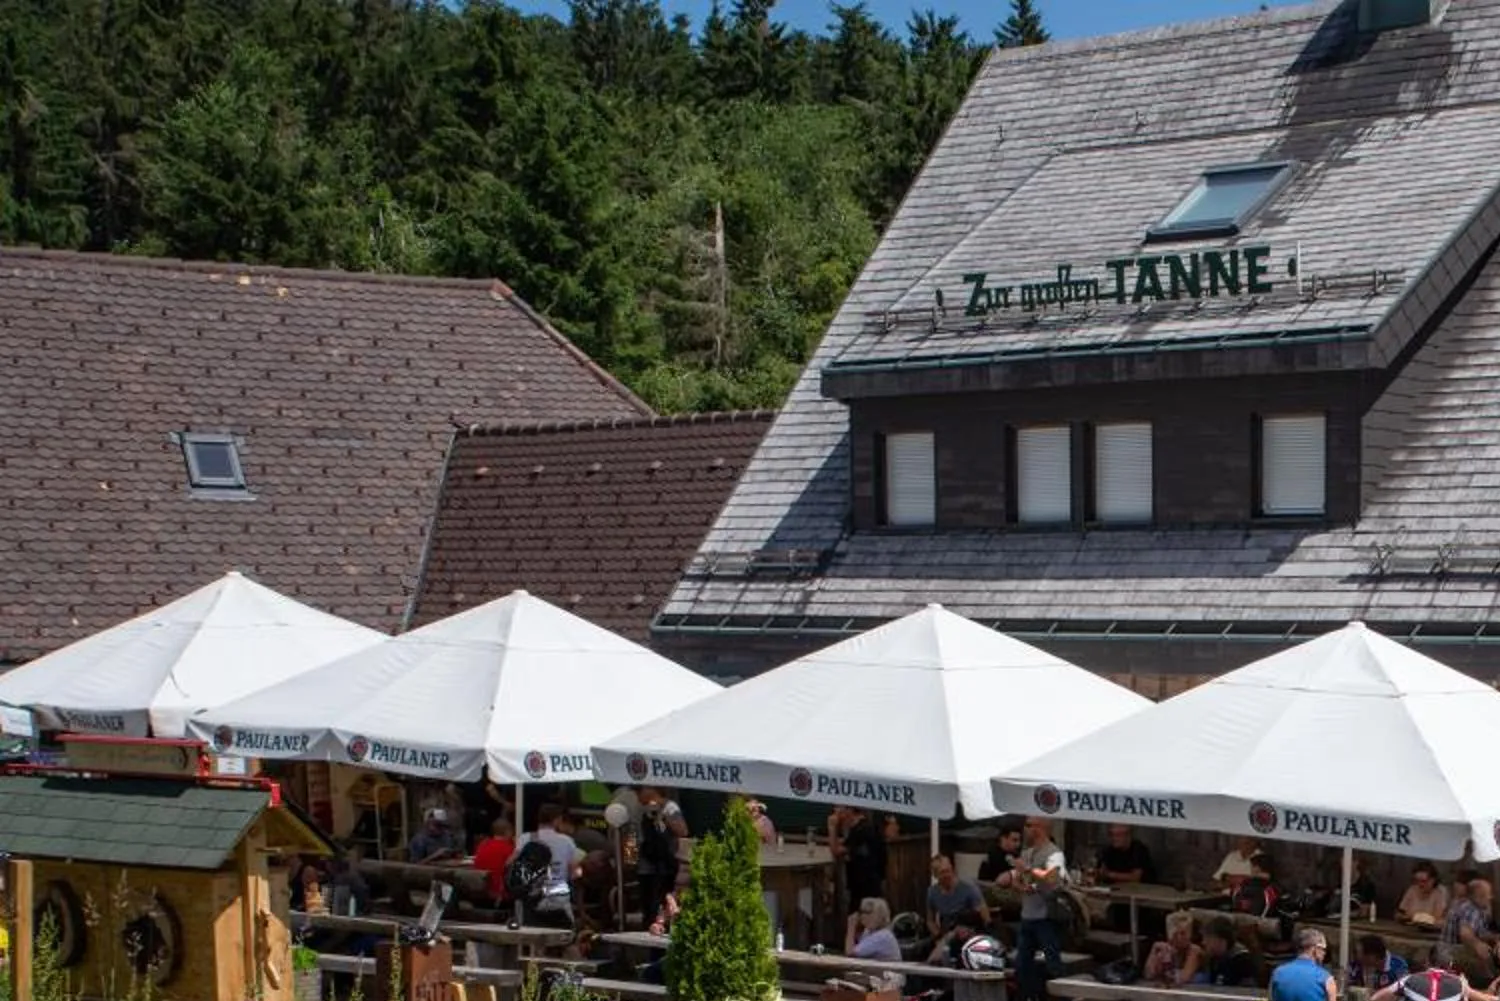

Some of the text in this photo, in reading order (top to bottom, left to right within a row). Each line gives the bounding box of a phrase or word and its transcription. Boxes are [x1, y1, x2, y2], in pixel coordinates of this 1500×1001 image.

[962, 272, 1013, 316] Zur
[1101, 245, 1272, 304] TANNE
[235, 730, 310, 752] PAULANER
[370, 743, 450, 769] PAULANER
[651, 758, 742, 784] PAULANER
[817, 774, 916, 806] PAULANER
[1066, 789, 1186, 819] PAULANER
[1283, 809, 1412, 845] PAULANER
